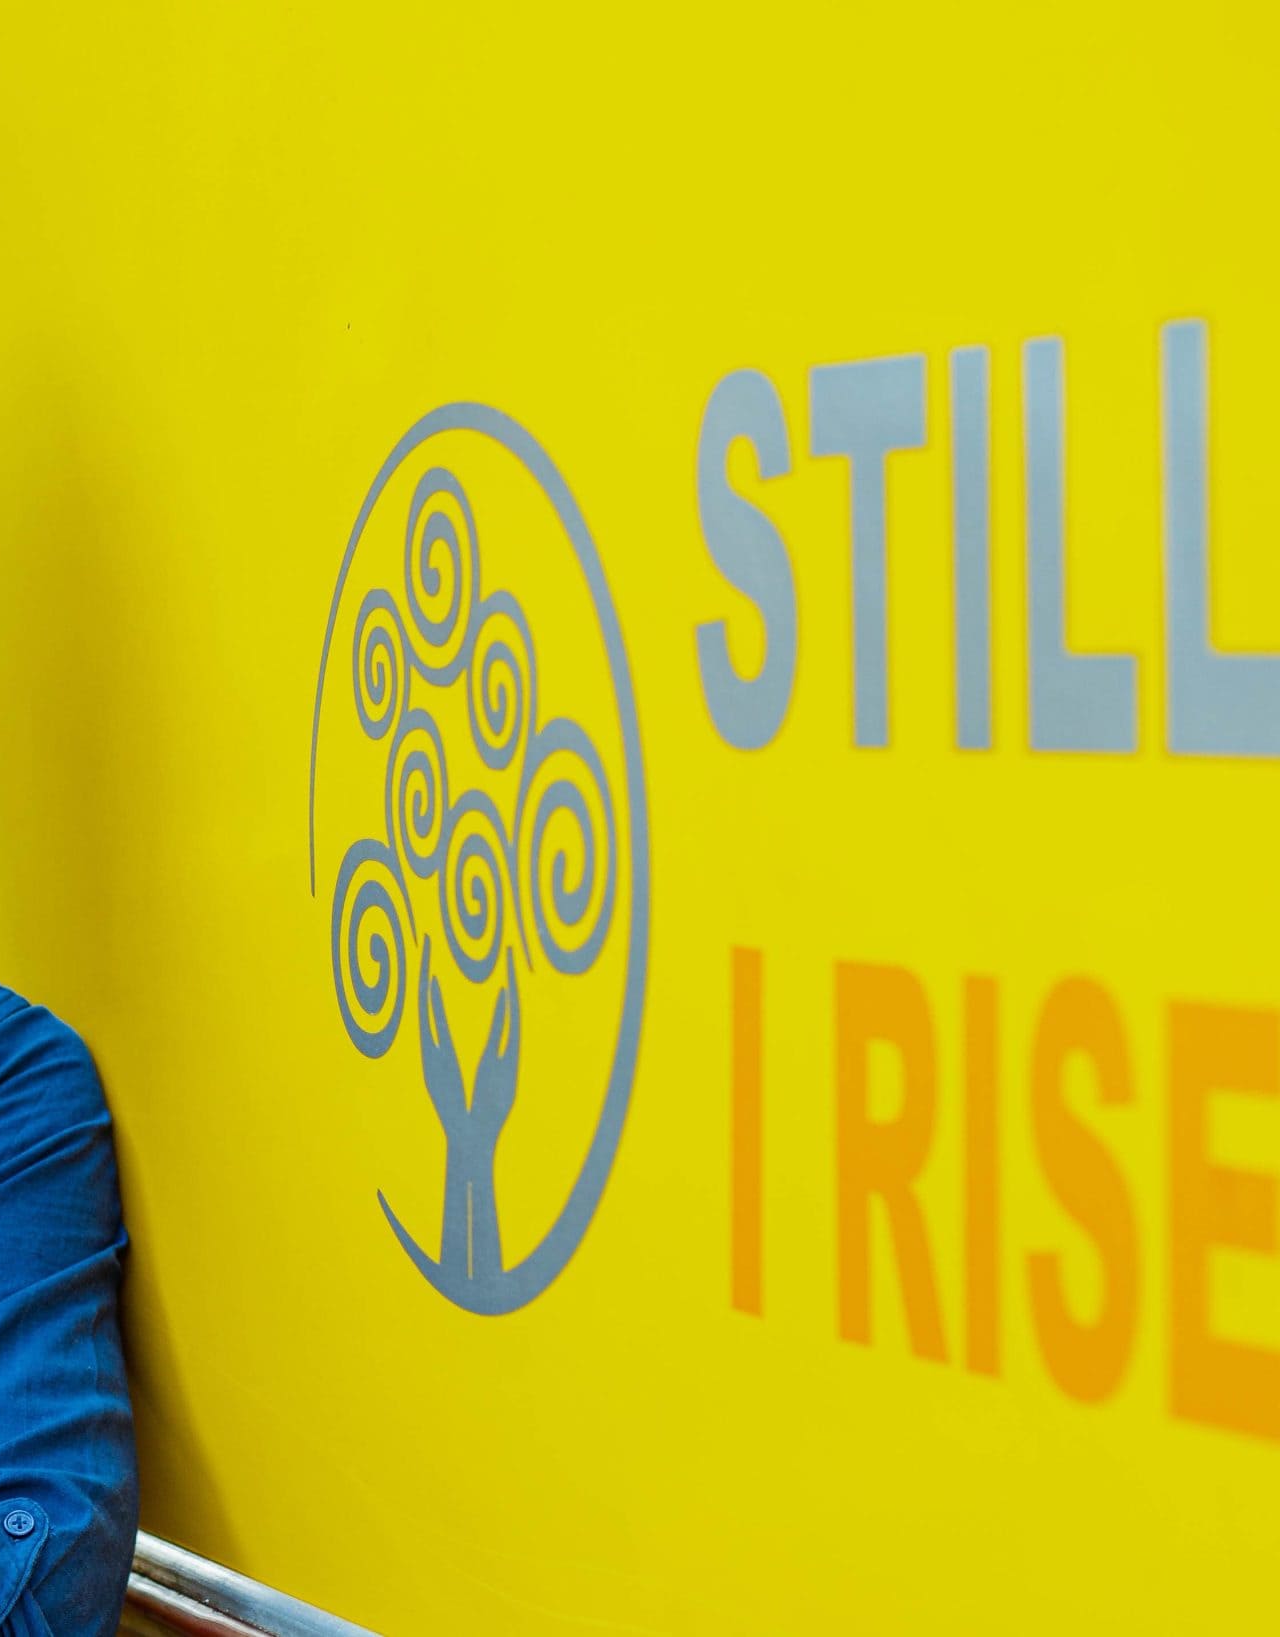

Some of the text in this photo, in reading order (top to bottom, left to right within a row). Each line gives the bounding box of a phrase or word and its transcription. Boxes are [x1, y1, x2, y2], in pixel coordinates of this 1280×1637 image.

[694, 317, 1280, 758] STILL
[730, 945, 1280, 1446] I RISE
